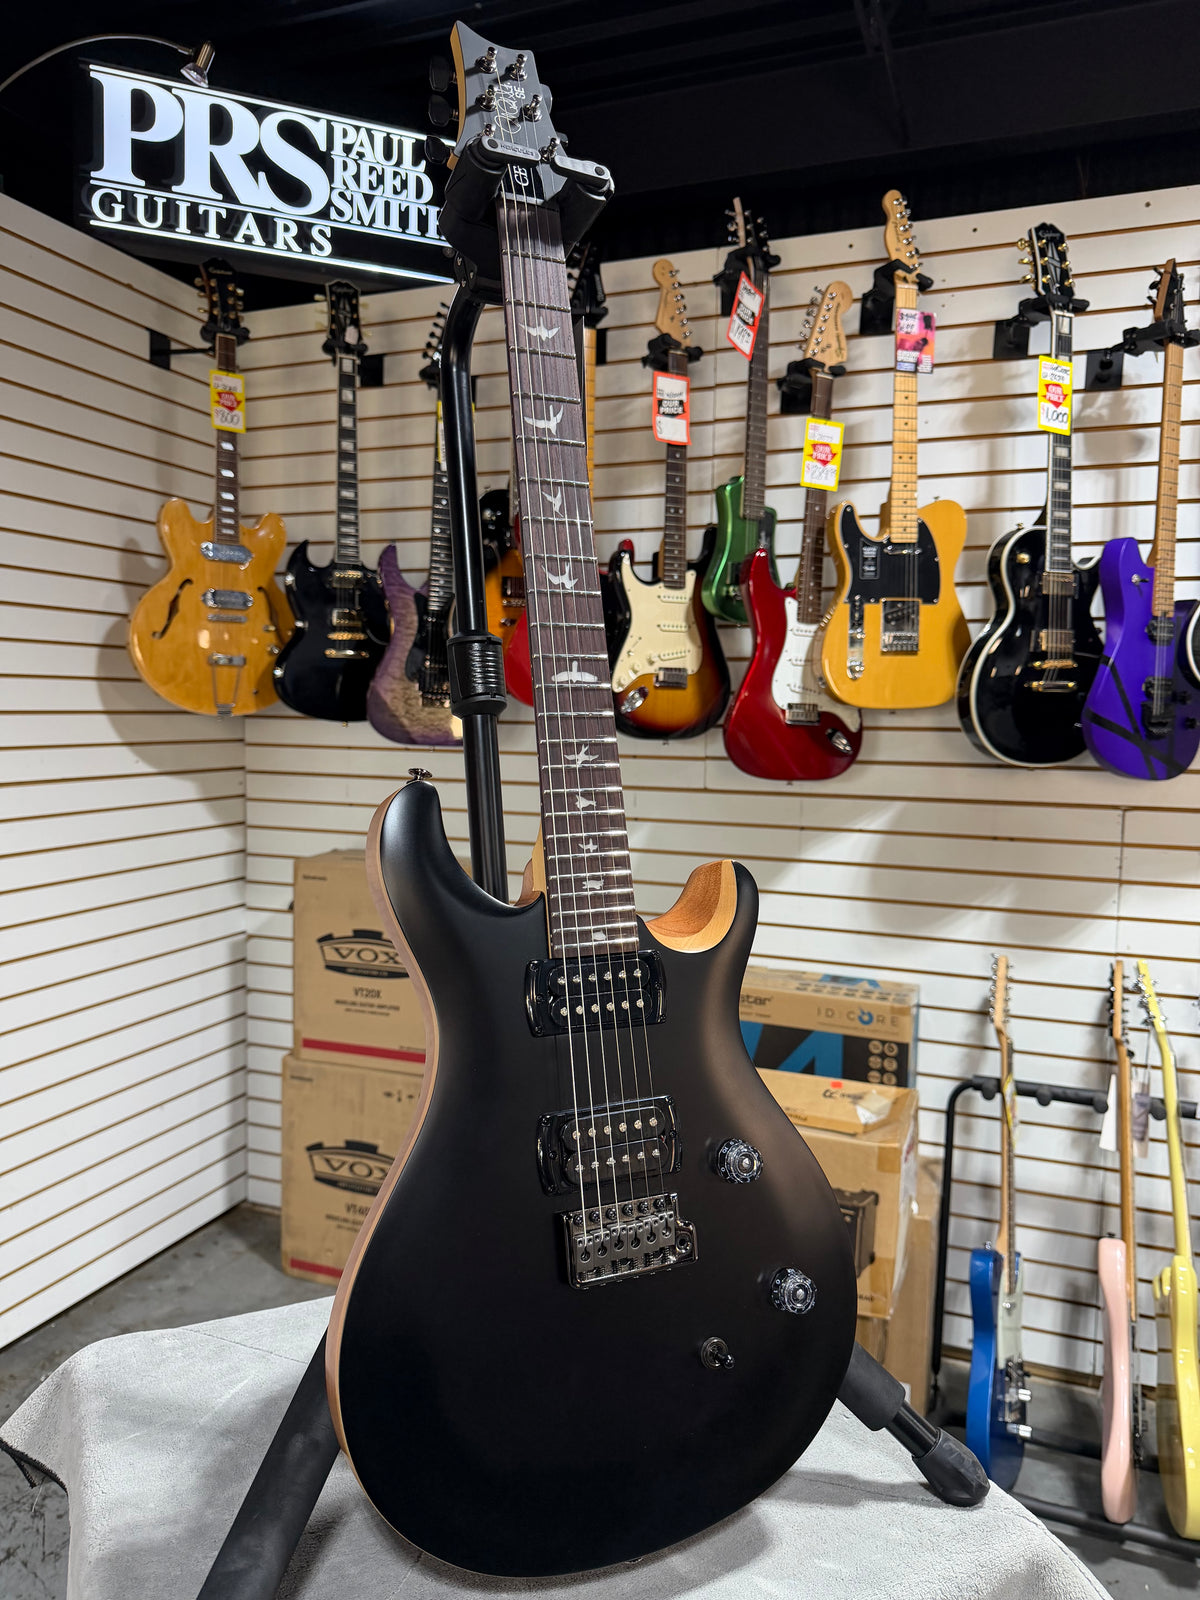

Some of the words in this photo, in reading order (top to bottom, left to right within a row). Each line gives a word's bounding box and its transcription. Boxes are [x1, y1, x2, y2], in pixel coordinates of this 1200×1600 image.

[90, 71, 331, 216] PRS
[331, 121, 427, 173] PAUL
[331, 154, 434, 204] REED
[91, 188, 333, 258] GUITARS
[659, 406, 685, 415] PRICE
[661, 399, 680, 408] OUR
[331, 946, 402, 965] VOX
